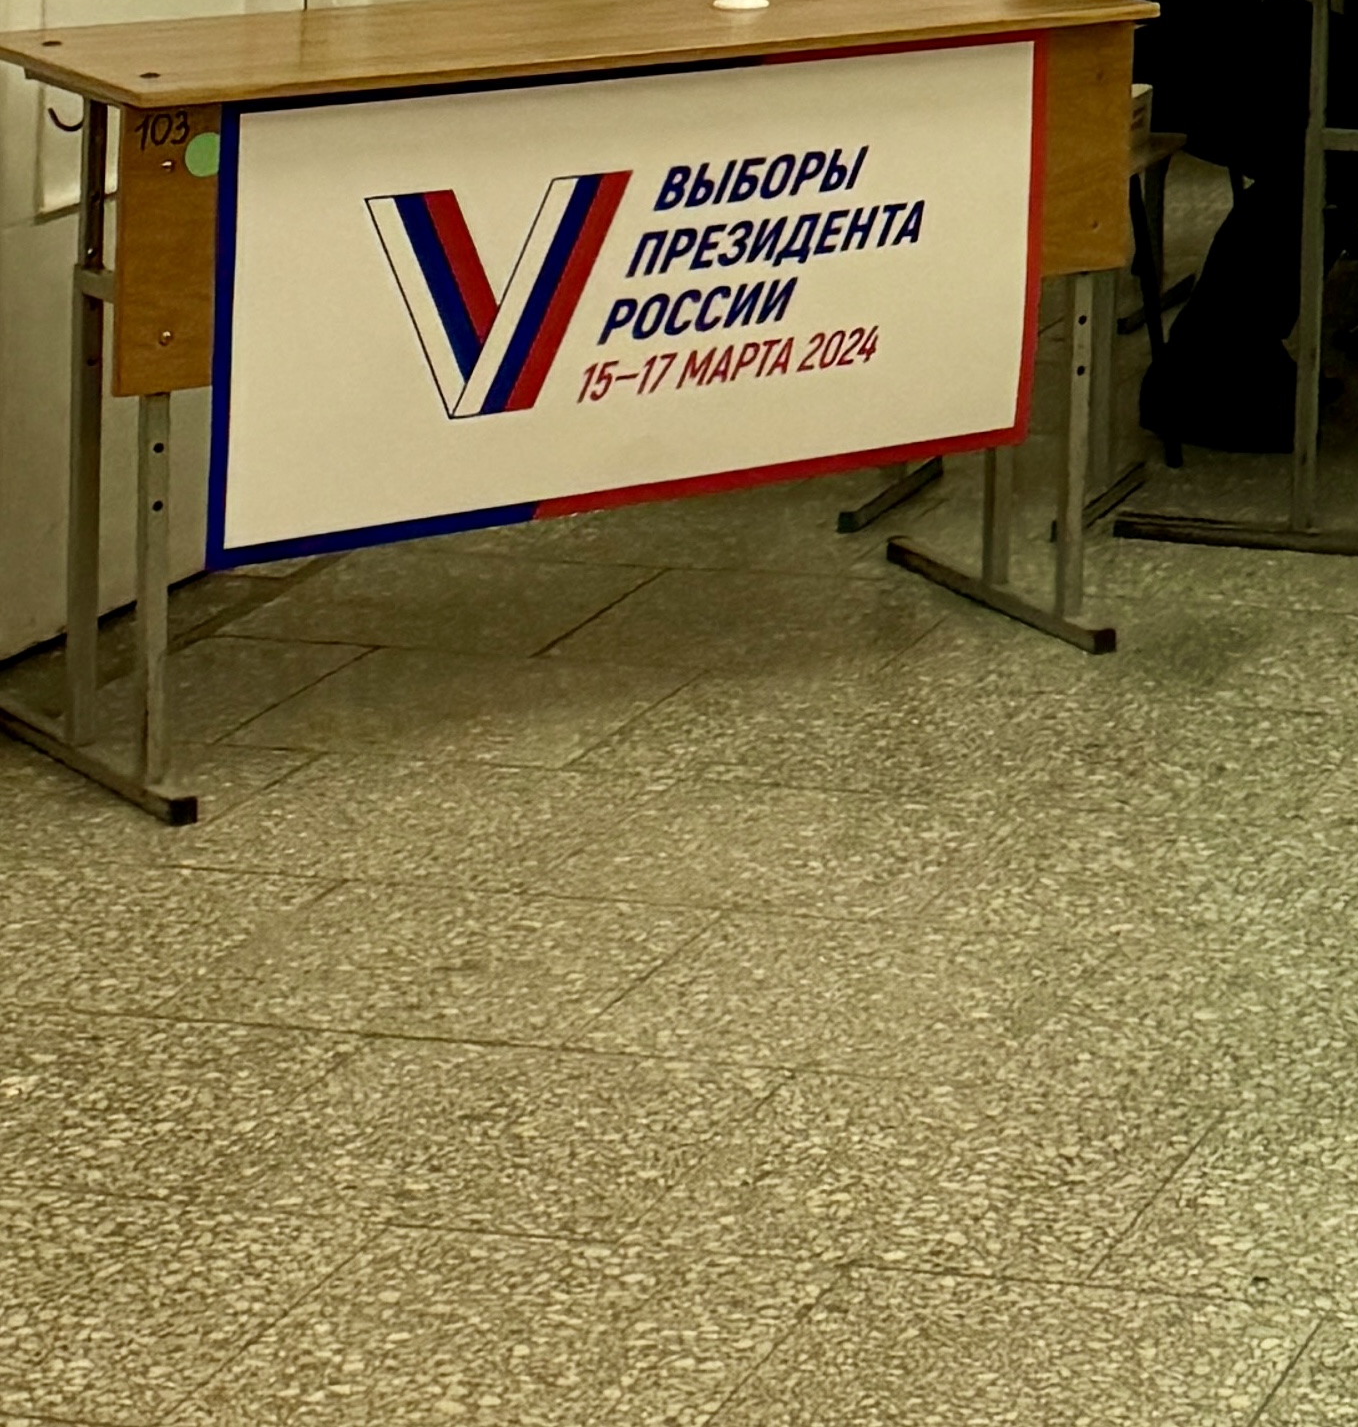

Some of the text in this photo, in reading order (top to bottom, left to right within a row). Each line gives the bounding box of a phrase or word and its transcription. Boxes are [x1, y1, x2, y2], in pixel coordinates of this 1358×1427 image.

[135, 110, 190, 151] 103
[653, 145, 869, 212] ВЫБОРЫ
[625, 200, 925, 279] ПРЕЗИДЕНТА
[596, 277, 798, 346] РОССИИ
[675, 337, 795, 390] МАРТА
[795, 325, 879, 374] 2024
